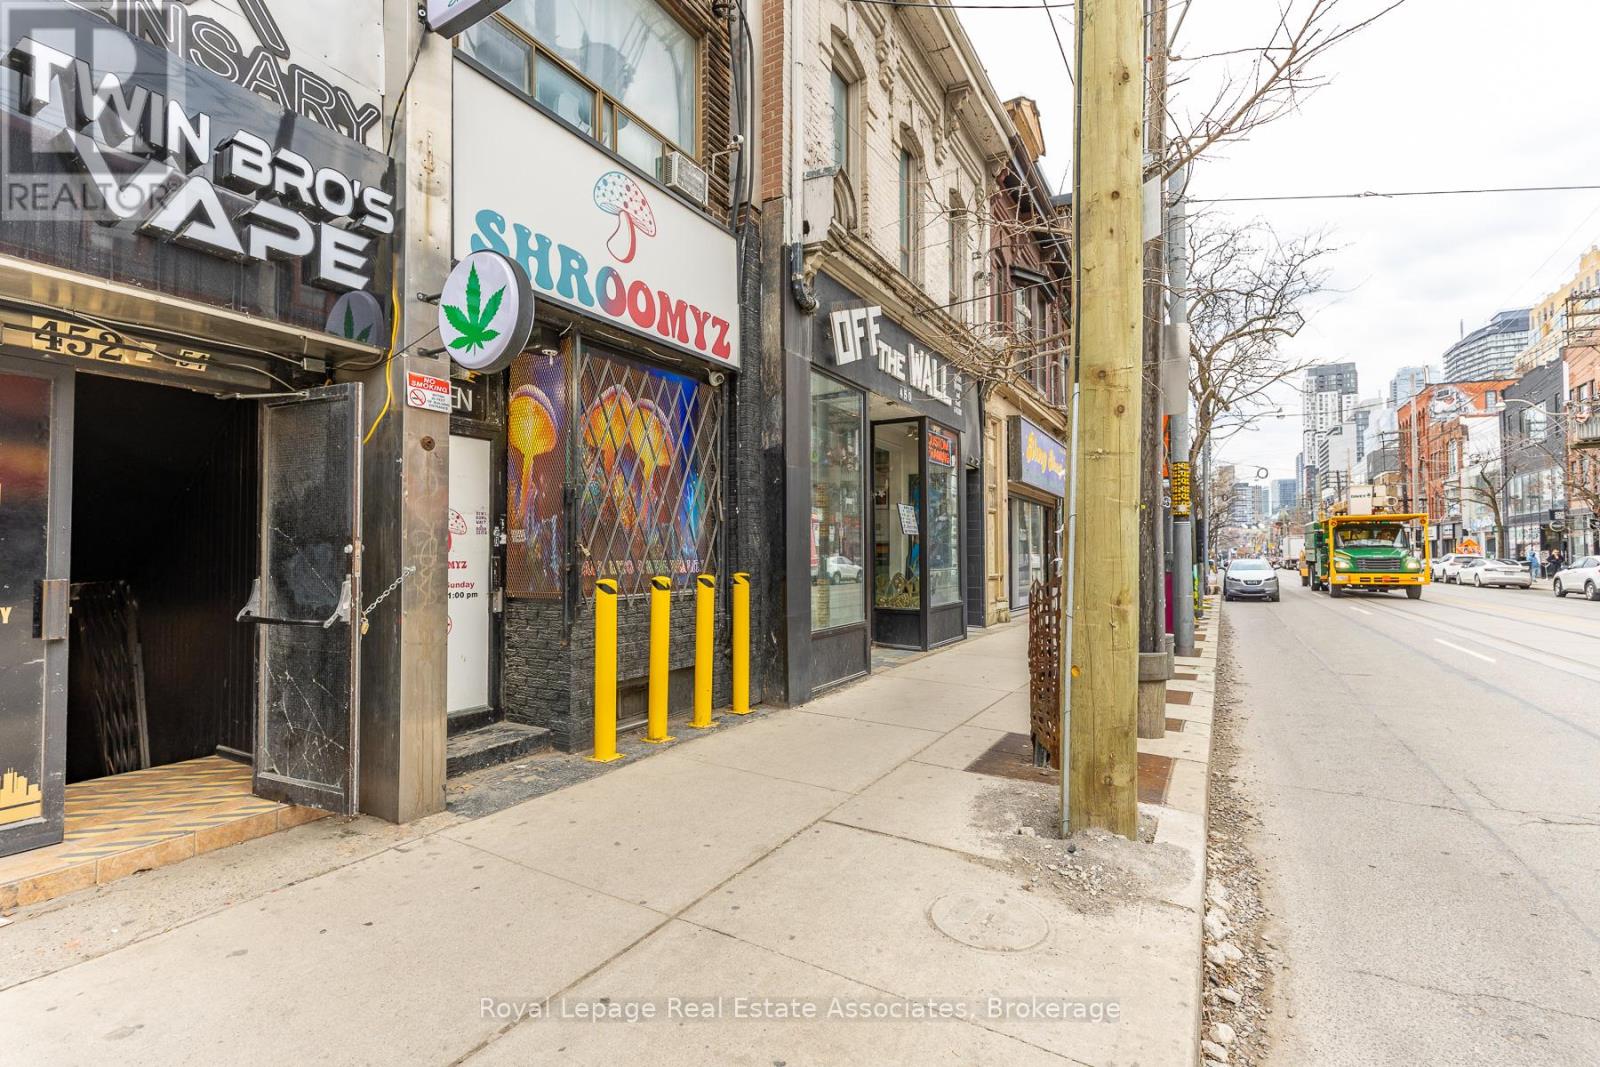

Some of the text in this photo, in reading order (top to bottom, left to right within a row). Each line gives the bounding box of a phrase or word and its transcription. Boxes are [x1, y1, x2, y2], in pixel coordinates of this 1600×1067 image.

[10, 36, 394, 235] TWIN BRO'S
[66, 127, 372, 291] VAPE
[470, 209, 731, 359] SHROOMYZ
[34, 320, 123, 362] 452
[830, 305, 882, 366] OFF
[877, 339, 906, 381] THE
[907, 342, 953, 407] WALL
[411, 380, 448, 394] SMOKING
[423, 377, 436, 385] NO
[466, 592, 478, 600] pm
